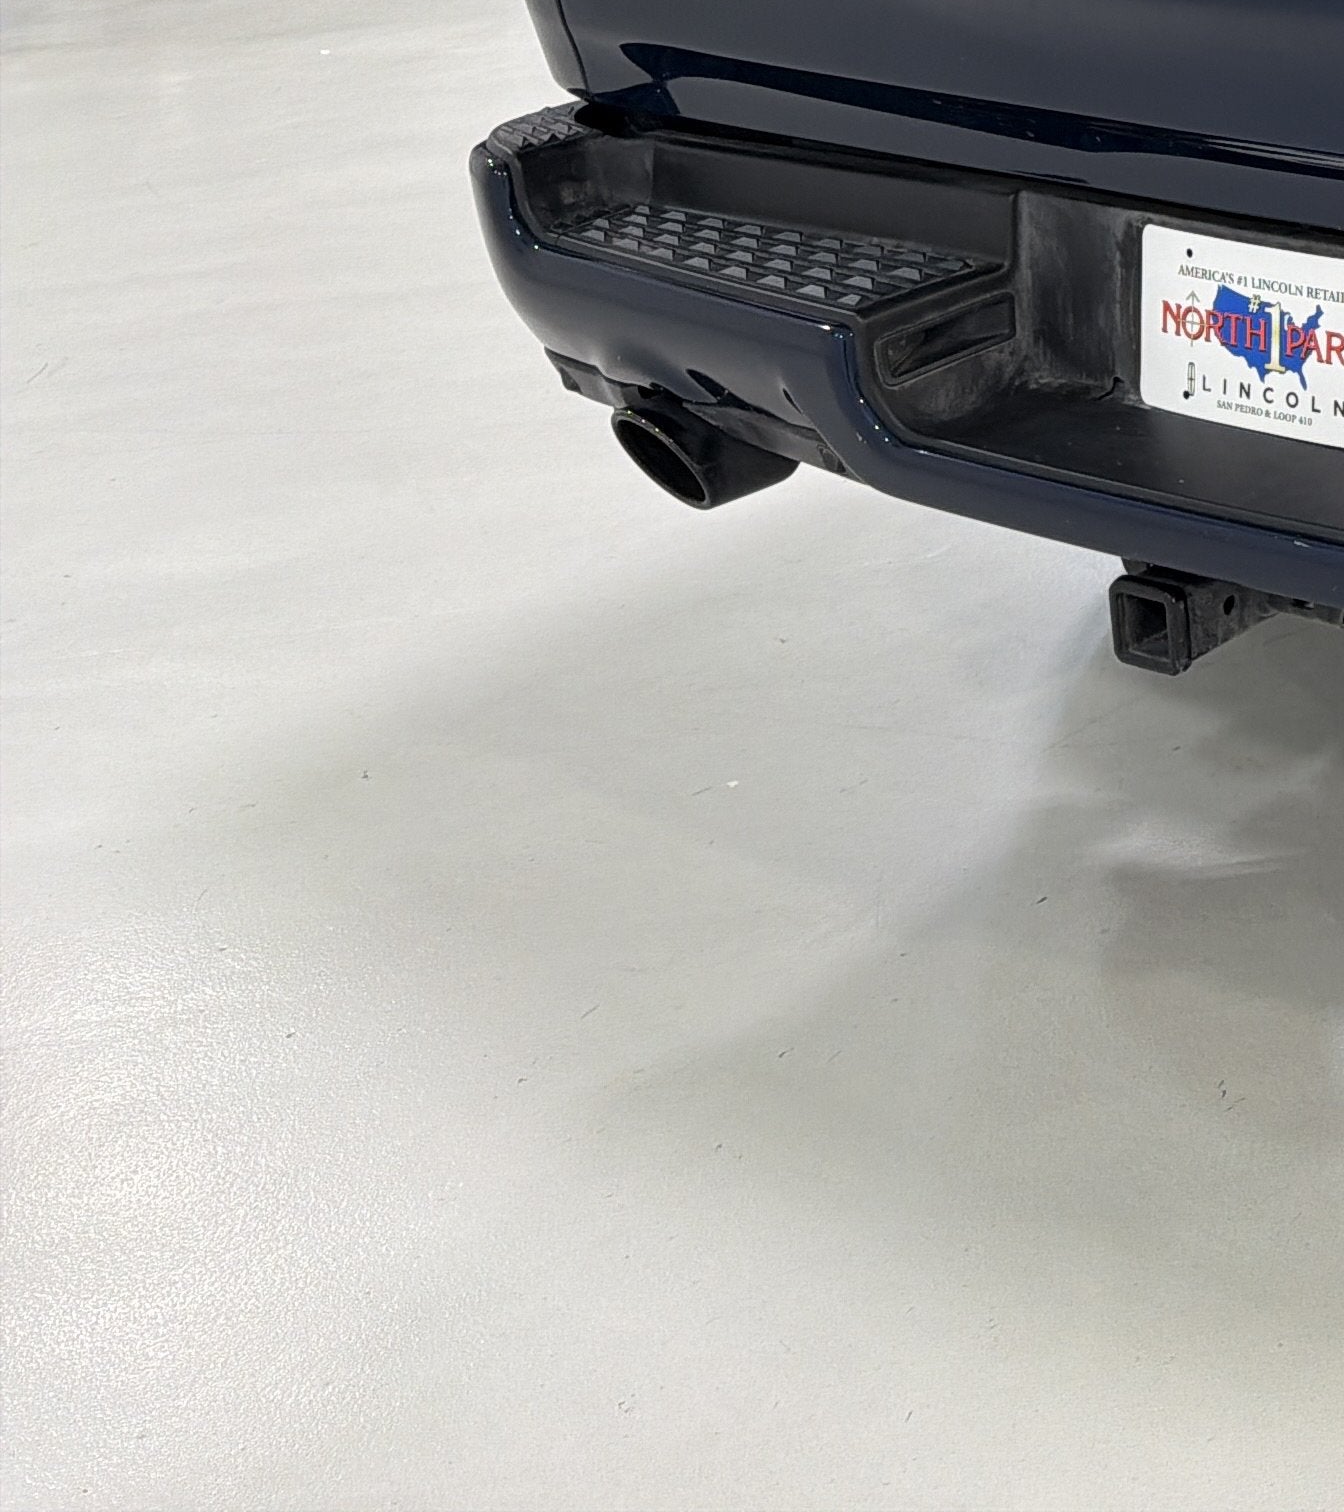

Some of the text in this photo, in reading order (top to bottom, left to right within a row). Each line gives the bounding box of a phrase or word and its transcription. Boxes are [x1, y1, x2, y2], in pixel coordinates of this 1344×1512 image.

[1178, 264, 1235, 284] AMERICA'S
[1236, 274, 1248, 288] #1
[1252, 277, 1304, 297] LINCOLN
[1161, 299, 1269, 352] NORTH
[1217, 400, 1312, 426] SAN PEDRO & LOOP 410
